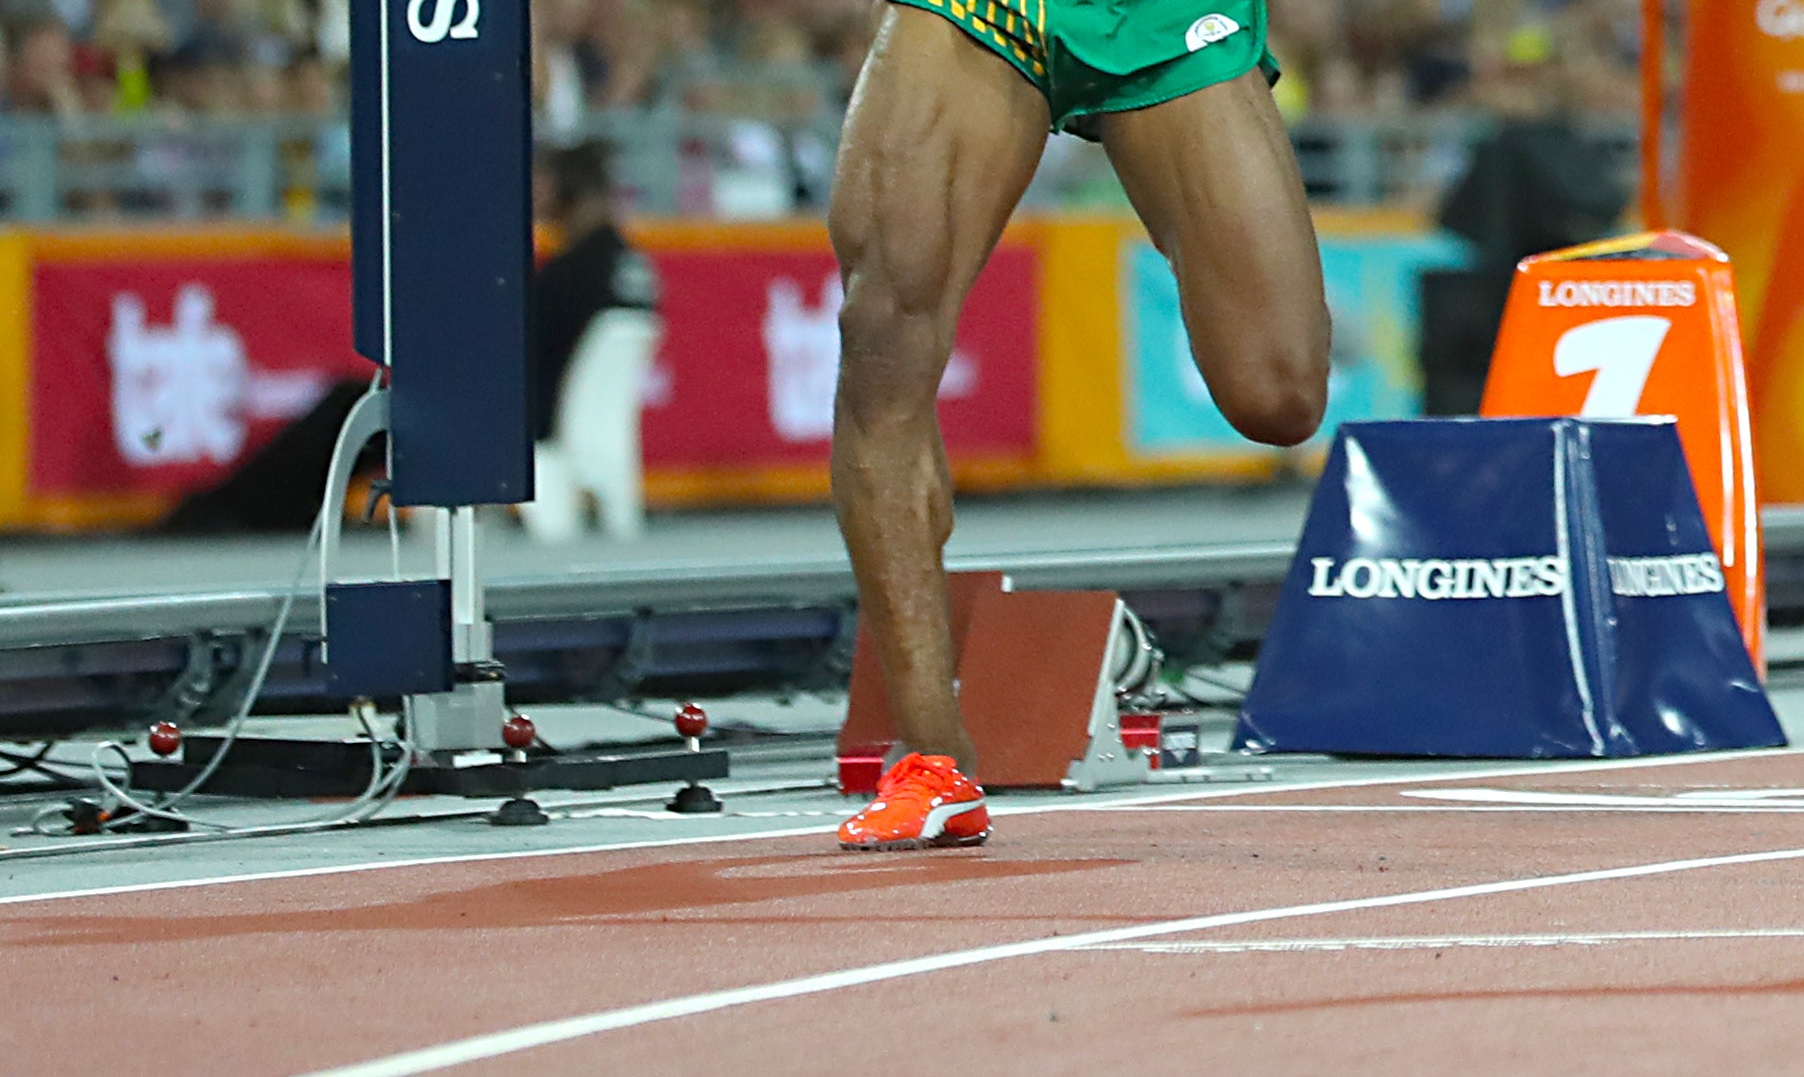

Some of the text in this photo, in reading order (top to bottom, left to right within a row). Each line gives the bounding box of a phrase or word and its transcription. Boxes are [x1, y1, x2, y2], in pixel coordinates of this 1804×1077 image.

[1538, 280, 1697, 308] LONGINES
[1553, 314, 1673, 419] 1
[1308, 556, 1567, 599] LONGINES
